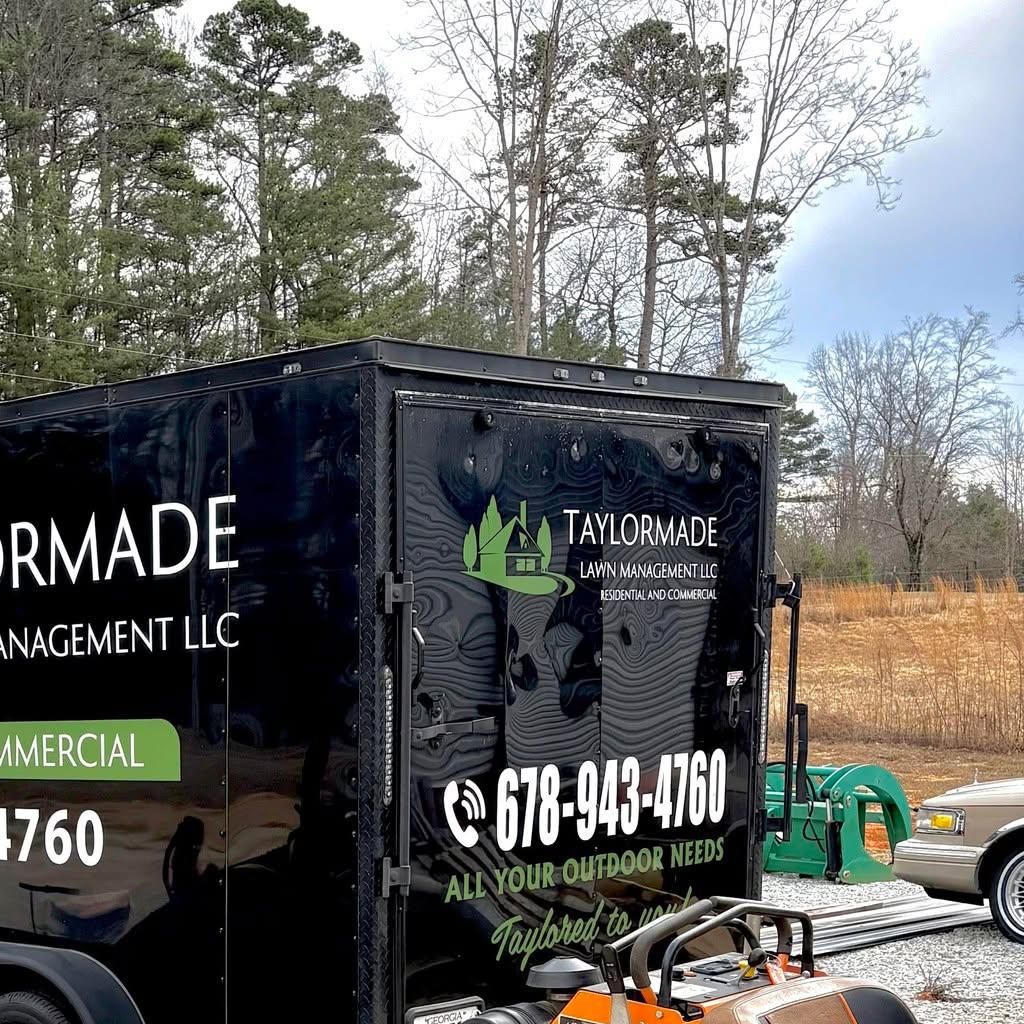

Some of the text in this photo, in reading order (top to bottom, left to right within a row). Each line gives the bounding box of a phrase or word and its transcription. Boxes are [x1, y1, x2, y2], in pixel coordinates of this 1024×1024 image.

[563, 509, 718, 547] TAYLORMADE
[580, 561, 718, 579] LAWN MANAGEMENT LLC
[600, 589, 718, 601] RESIDENTIAL AND COMMERCIAL
[184, 611, 239, 650] LLC
[496, 748, 727, 852] 678-943-4760
[444, 837, 725, 903] ALL YOUR OUTDOOR NEEDS
[491, 899, 606, 972] Taylored
[606, 906, 632, 937] to
